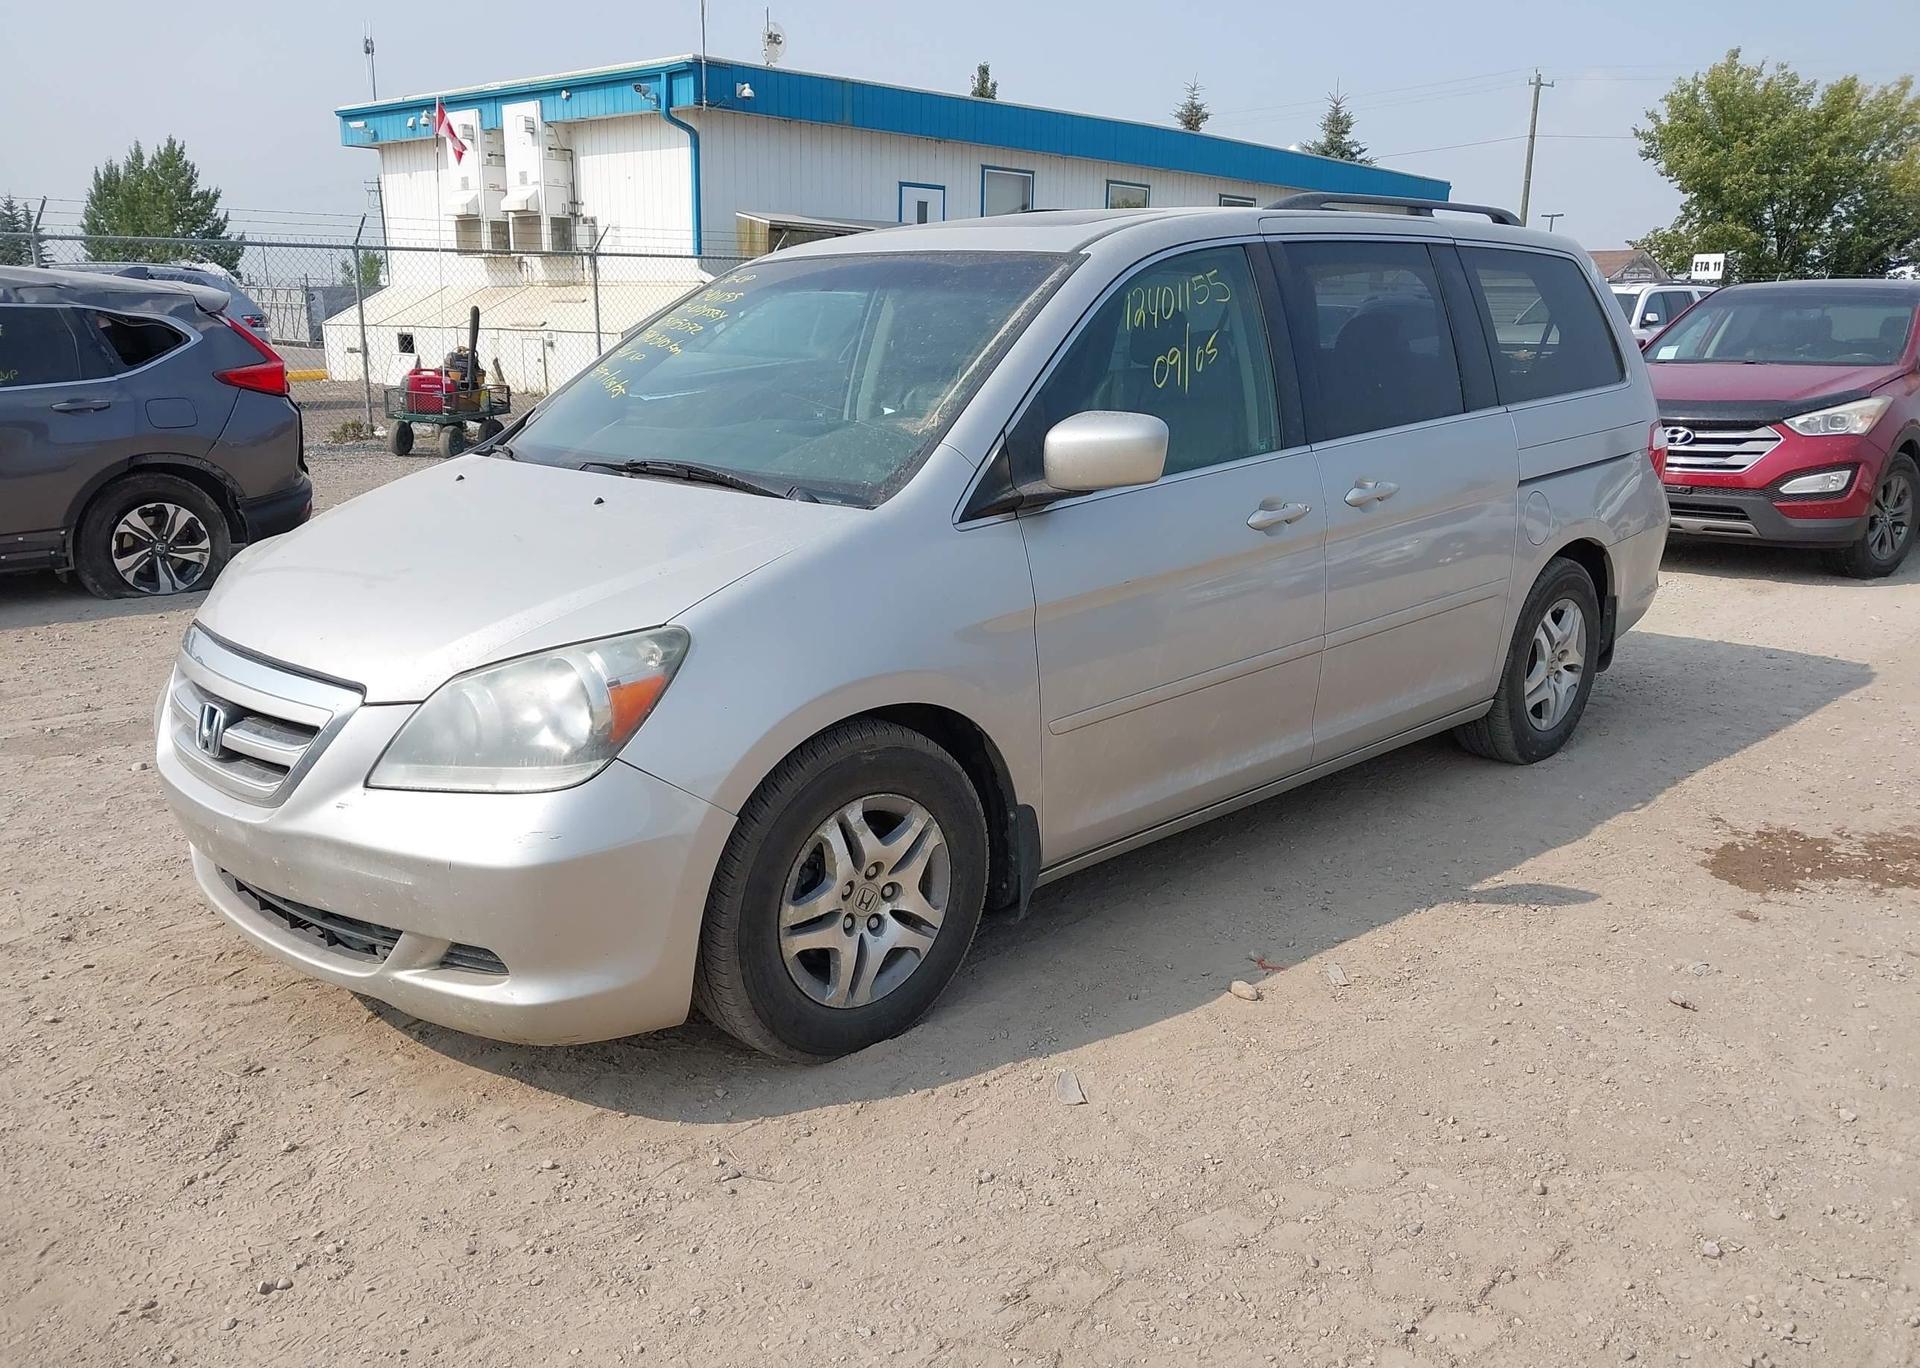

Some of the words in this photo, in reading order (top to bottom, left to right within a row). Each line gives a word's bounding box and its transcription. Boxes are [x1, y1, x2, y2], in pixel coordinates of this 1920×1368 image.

[1694, 261, 1710, 271] ETA
[1713, 261, 1721, 271] 11
[1126, 269, 1231, 331] 12401155
[1153, 322, 1219, 394] 09/05
